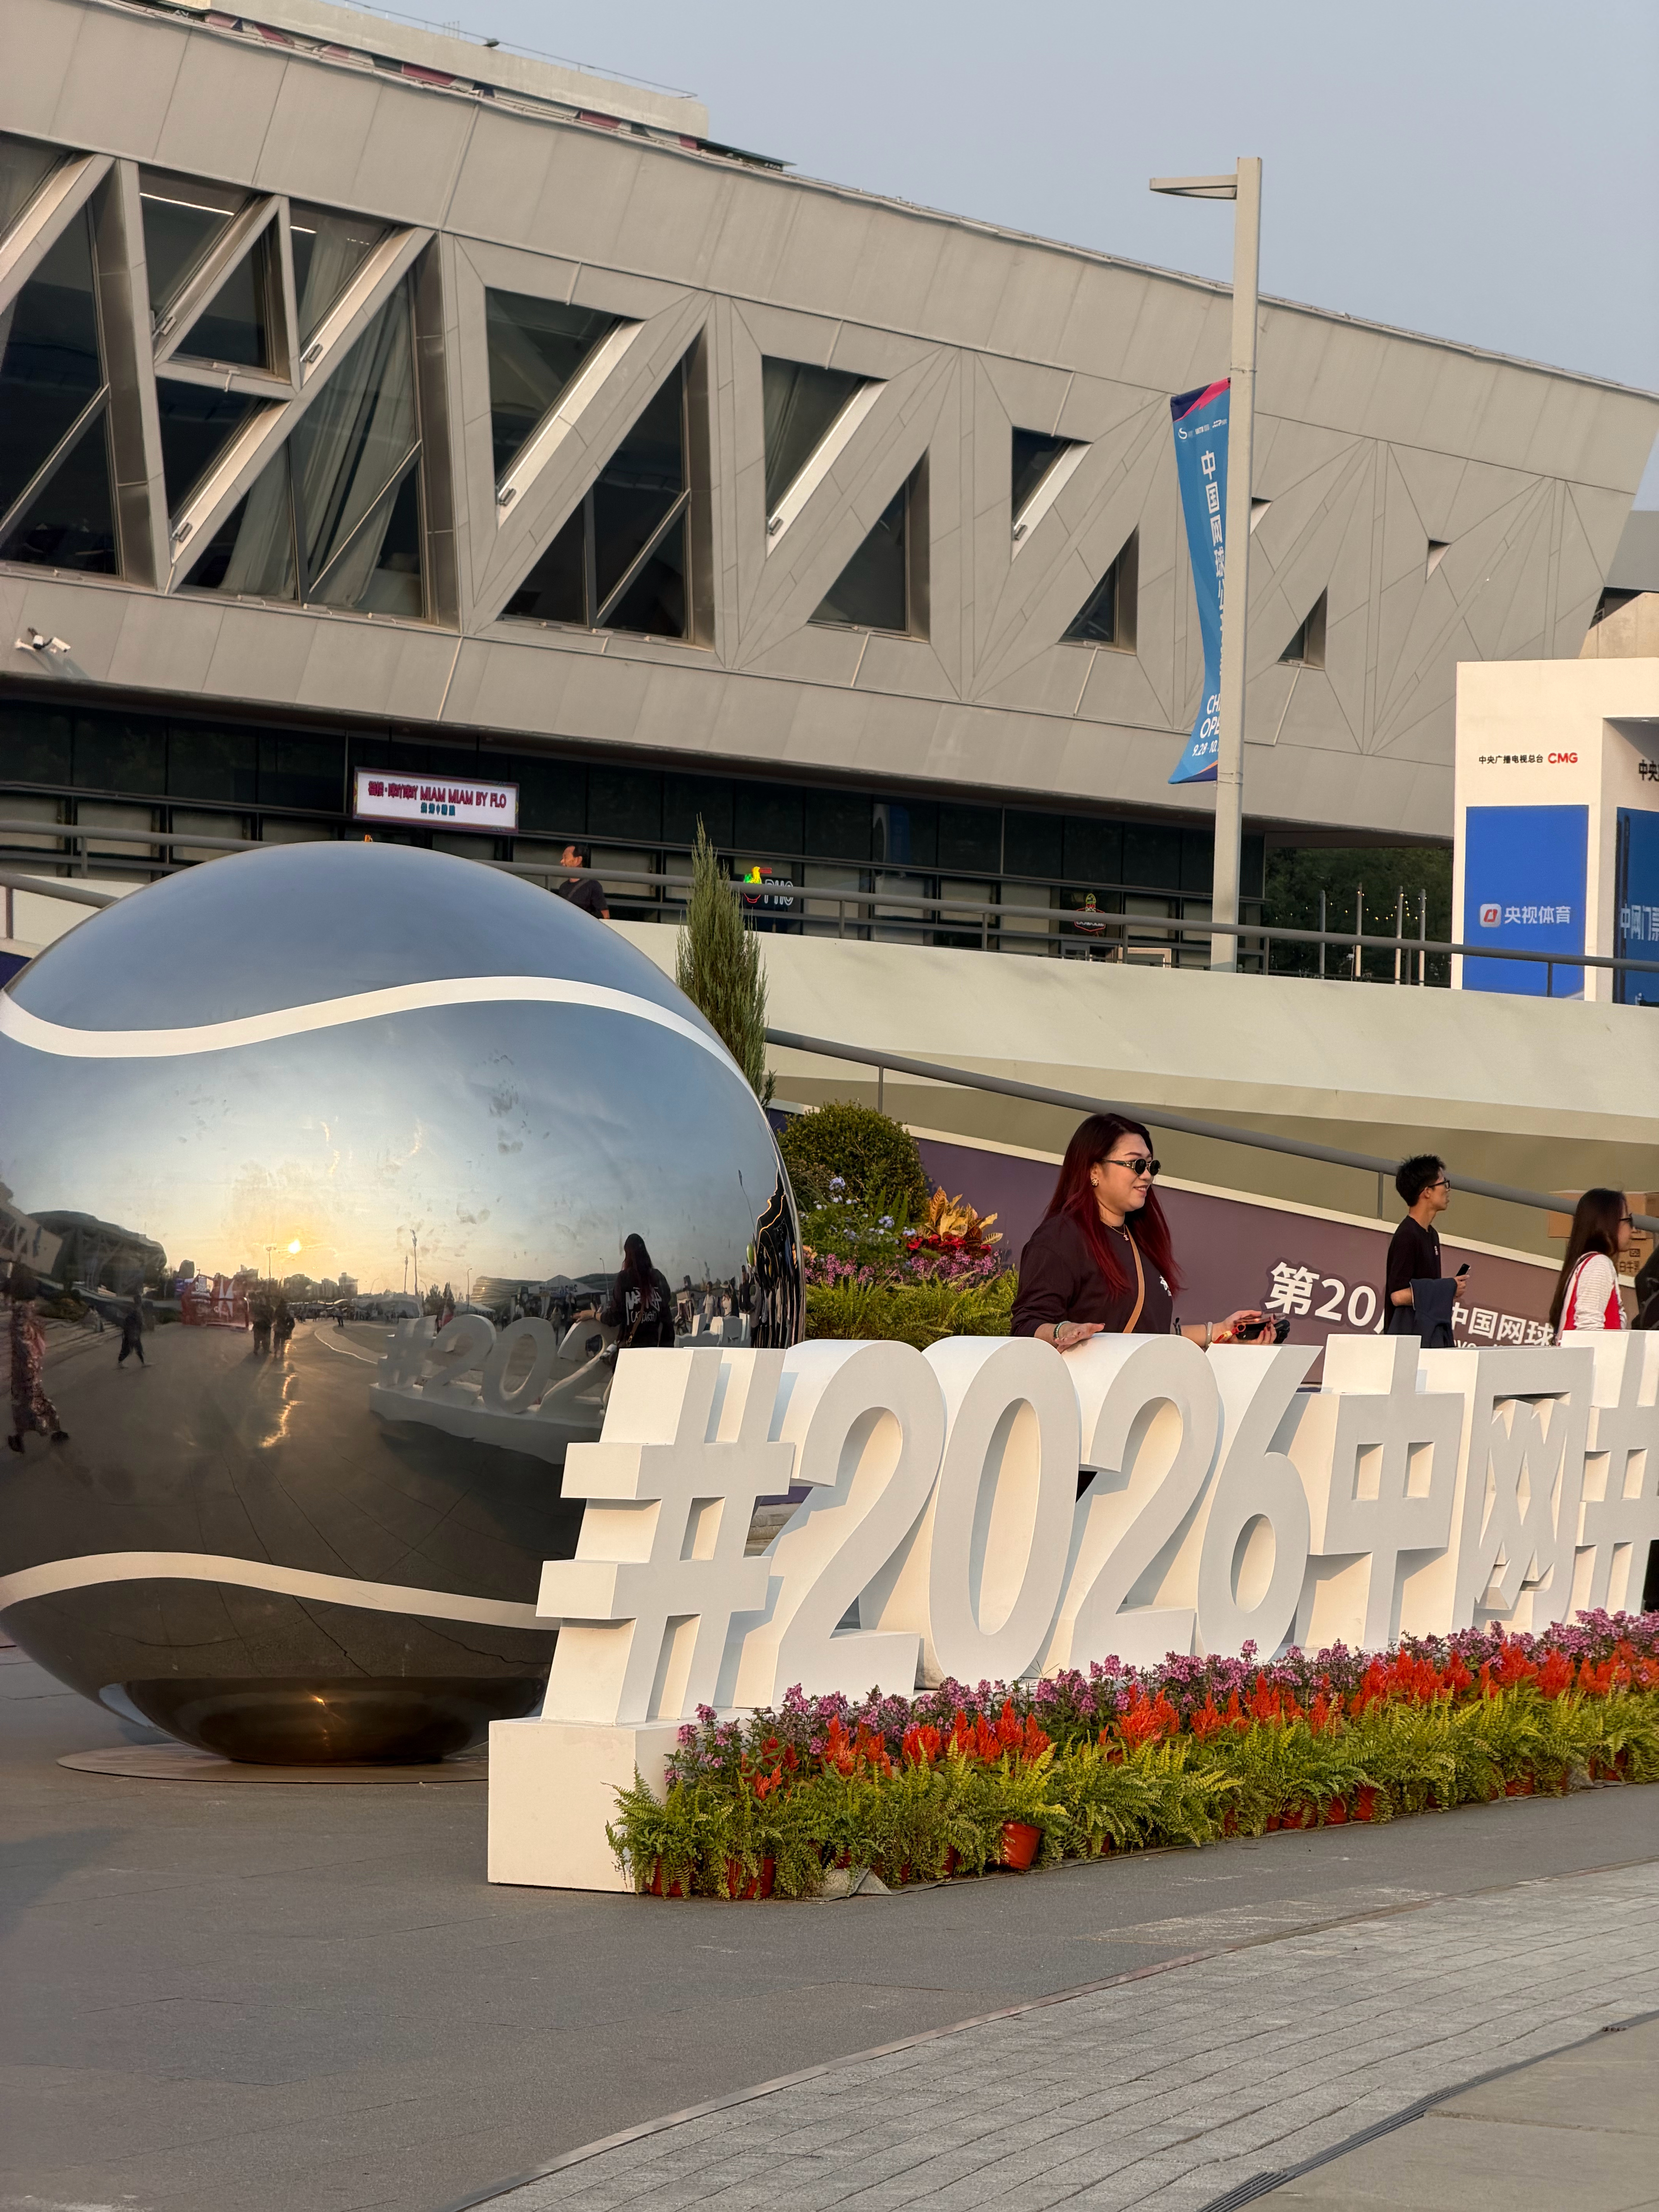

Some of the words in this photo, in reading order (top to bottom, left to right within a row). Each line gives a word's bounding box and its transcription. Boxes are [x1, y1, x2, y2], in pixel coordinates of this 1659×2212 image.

[1200, 716, 1219, 738] OPE
[1479, 754, 1544, 764] 中央广播电视总台
[1548, 752, 1578, 764] CMG
[1638, 759, 1659, 781] 中央
[420, 786, 446, 802] MIAM
[448, 788, 473, 805] MIAM
[476, 791, 488, 807] BY
[490, 792, 507, 808] FLO
[1504, 906, 1571, 924] 央视体育
[1264, 1261, 1385, 1334] 第20
